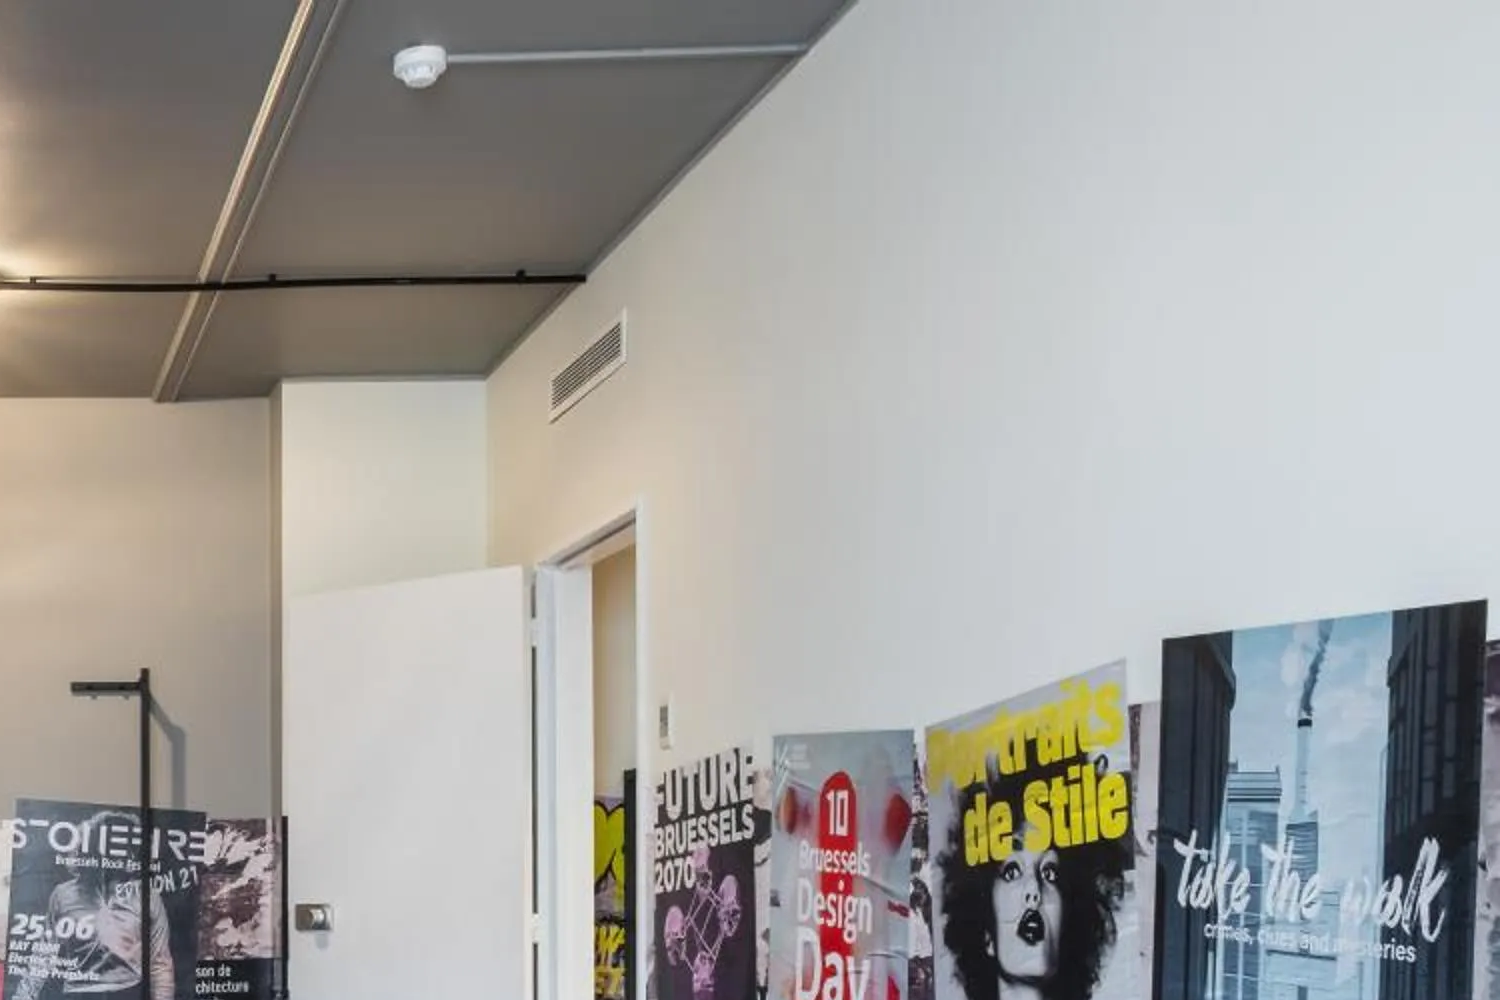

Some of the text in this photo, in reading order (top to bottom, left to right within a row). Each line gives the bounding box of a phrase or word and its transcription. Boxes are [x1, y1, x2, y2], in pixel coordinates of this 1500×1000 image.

[926, 678, 1125, 795] Portraits
[654, 747, 754, 826] FUTURE
[826, 788, 850, 836] 10
[963, 762, 1129, 867] de Stile
[653, 802, 755, 860] BRUESSELS
[798, 839, 872, 877] Bruessels
[655, 854, 696, 894] 2070
[1173, 829, 1450, 943] take the walk
[9, 913, 96, 940] 25.06
[797, 876, 873, 945] Design
